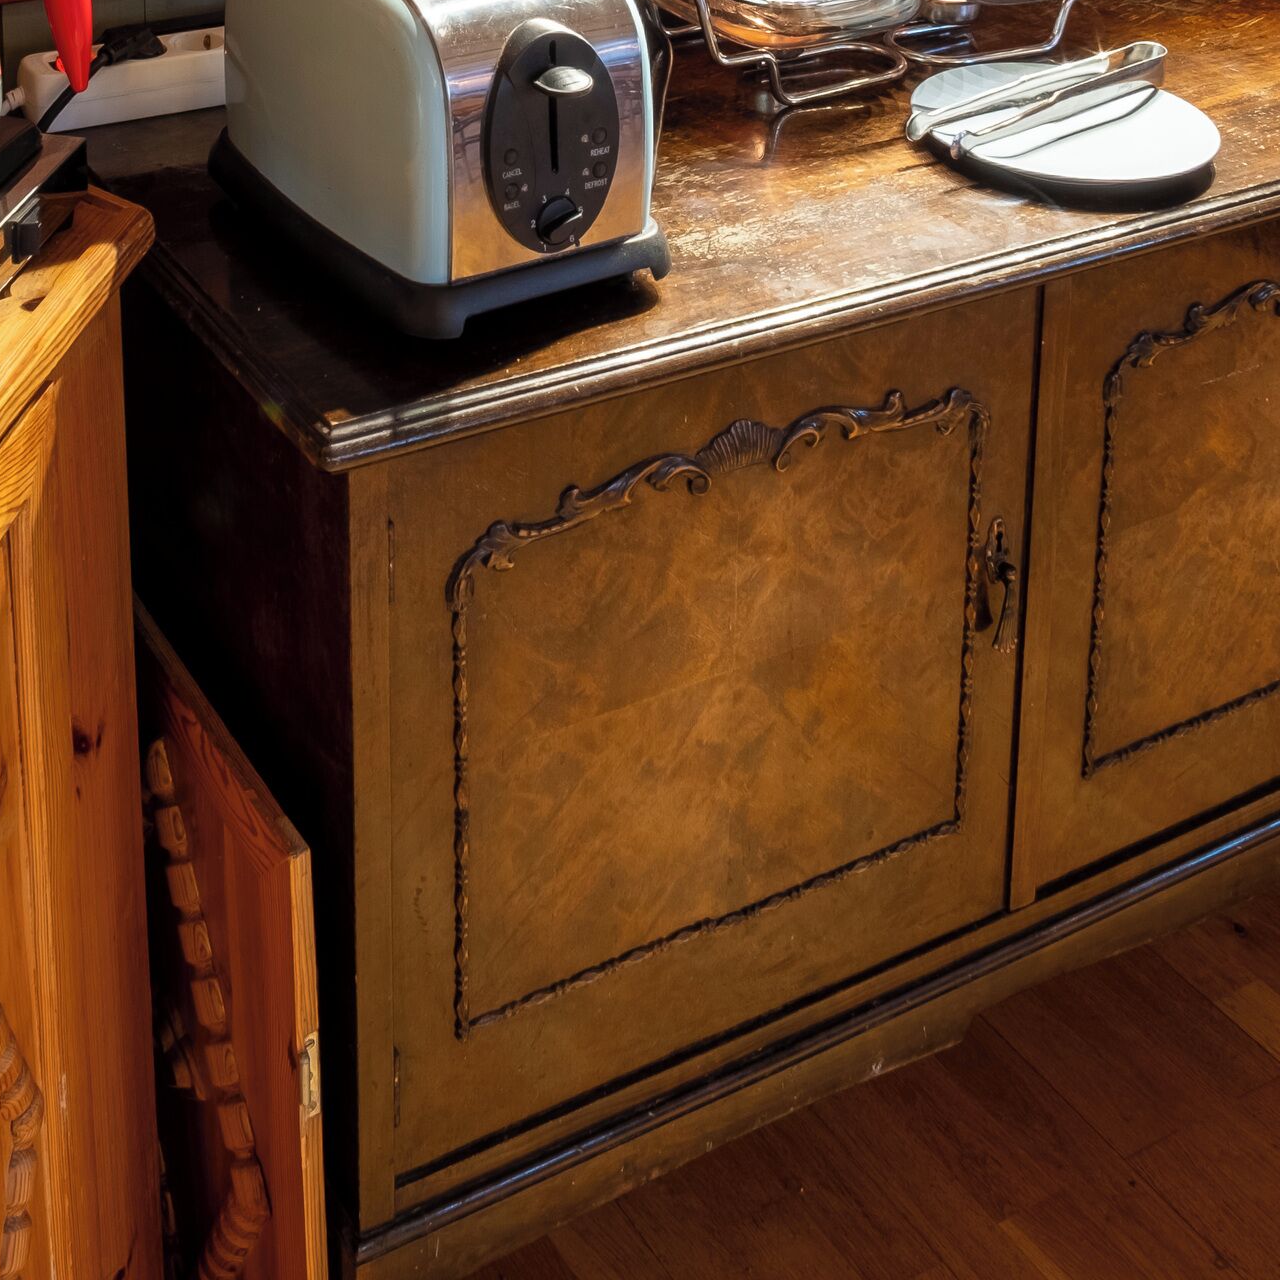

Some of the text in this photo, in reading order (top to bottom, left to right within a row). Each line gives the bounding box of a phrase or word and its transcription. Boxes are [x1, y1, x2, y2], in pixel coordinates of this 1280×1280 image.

[590, 145, 611, 157] REHEAT
[502, 167, 523, 179] CANCEL
[584, 177, 608, 190] DEFROST
[565, 187, 570, 197] 4
[542, 195, 548, 204] 3
[503, 200, 521, 212] BAGEL
[530, 219, 537, 229] 2
[569, 234, 575, 243] 6
